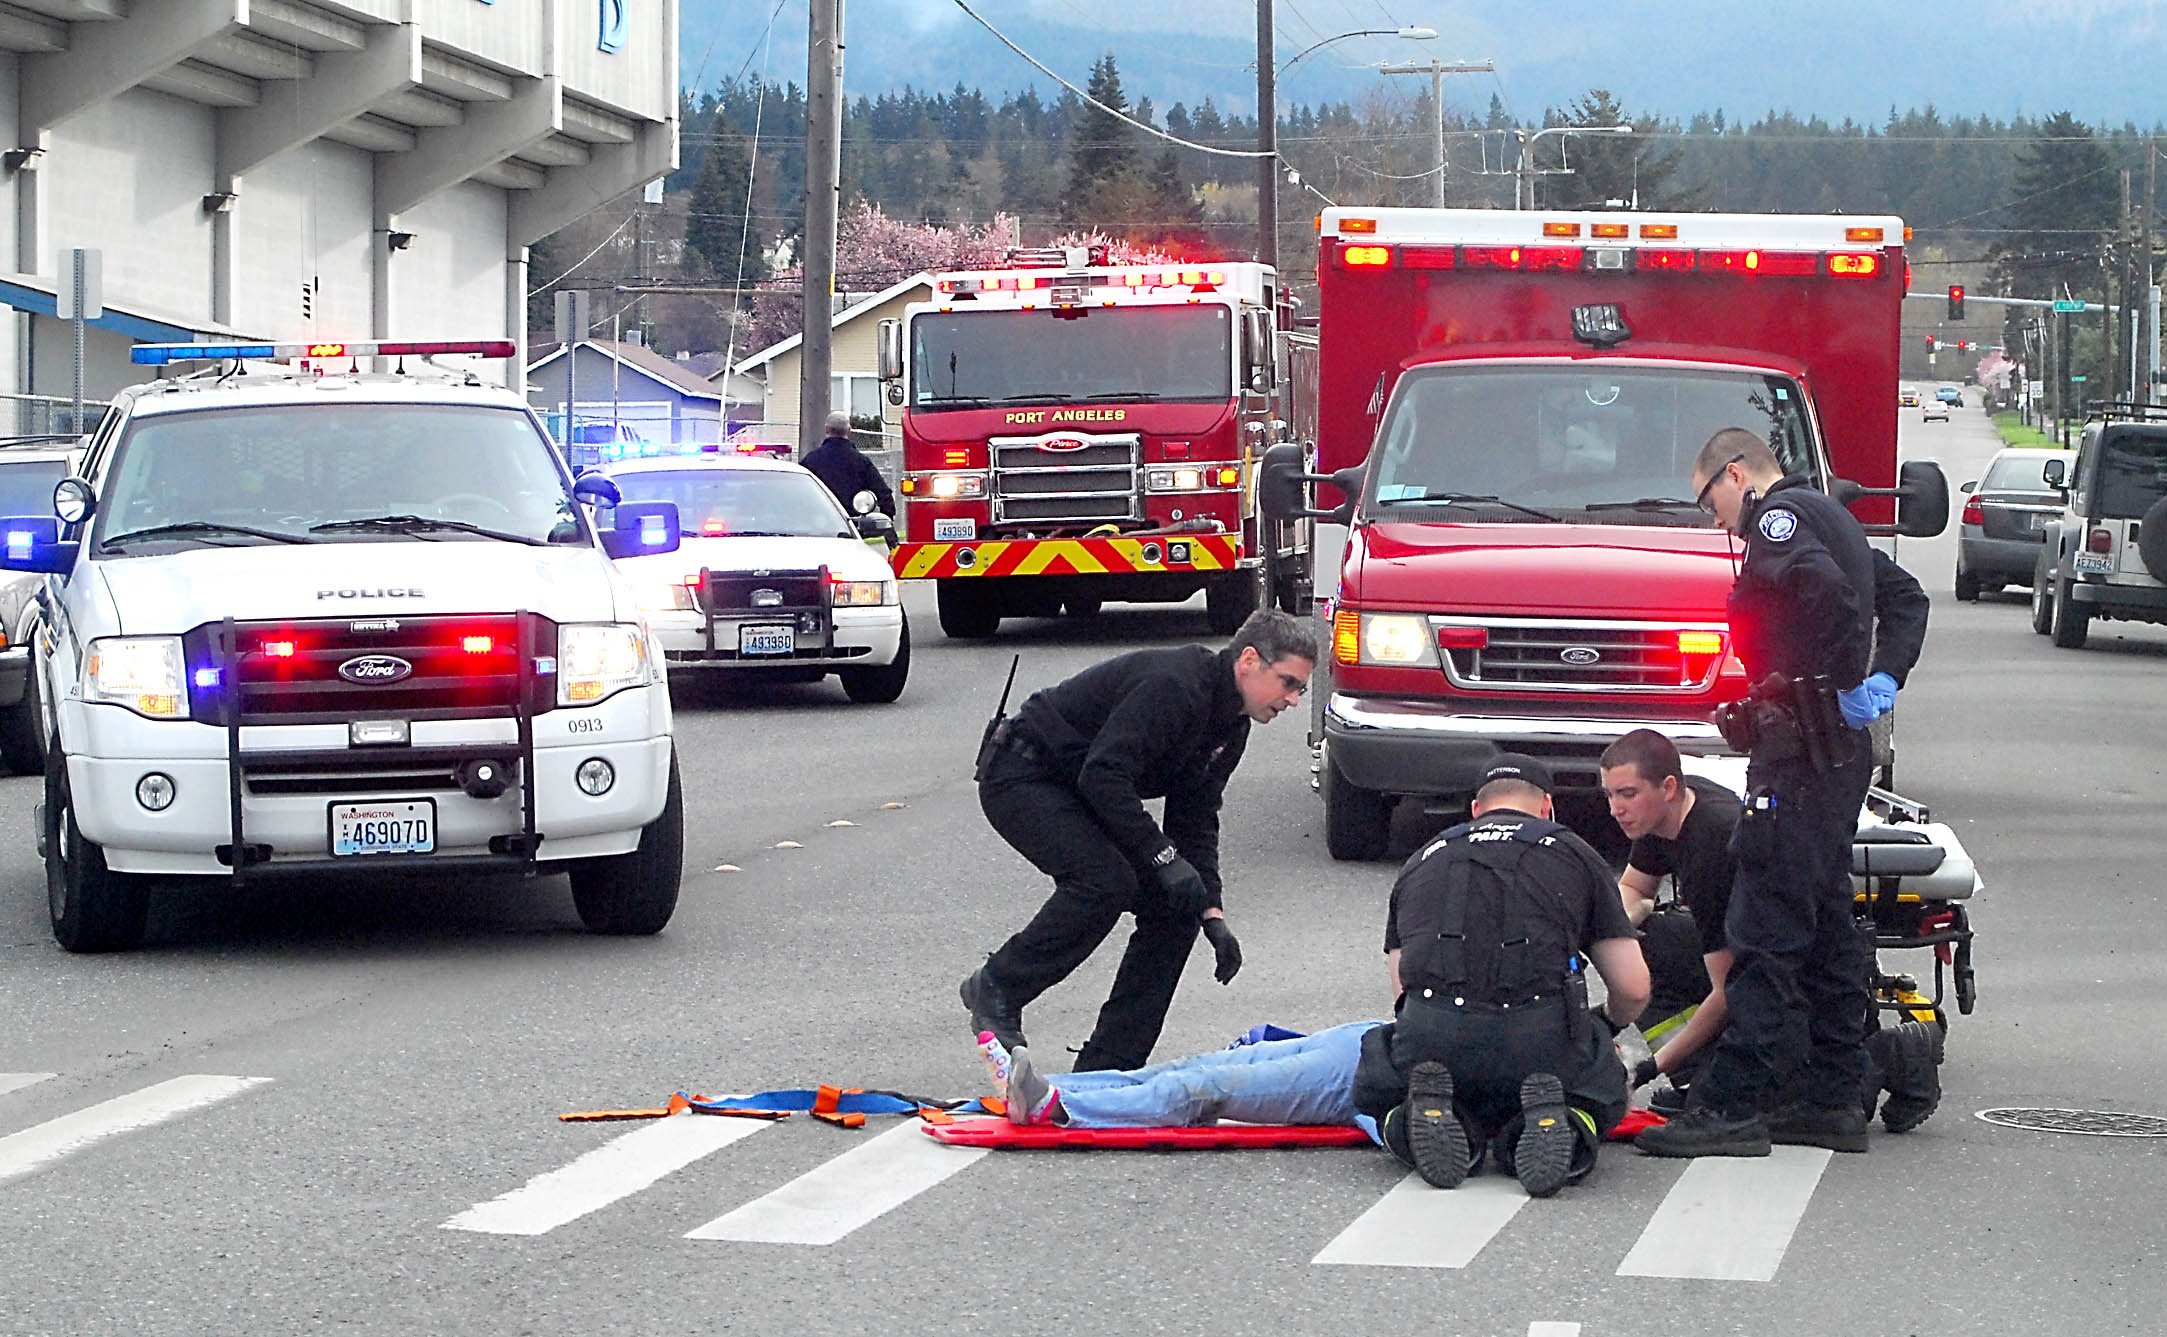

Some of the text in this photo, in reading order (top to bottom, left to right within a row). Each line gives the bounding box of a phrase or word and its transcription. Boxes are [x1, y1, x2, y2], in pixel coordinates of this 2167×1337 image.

[1005, 409, 1126, 424] PORT ANGELES
[317, 588, 425, 600] POLICE
[355, 659, 395, 677] Ford
[568, 718, 603, 733] 0913
[341, 811, 394, 819] WASHINGTON
[353, 819, 427, 846] 46907D
